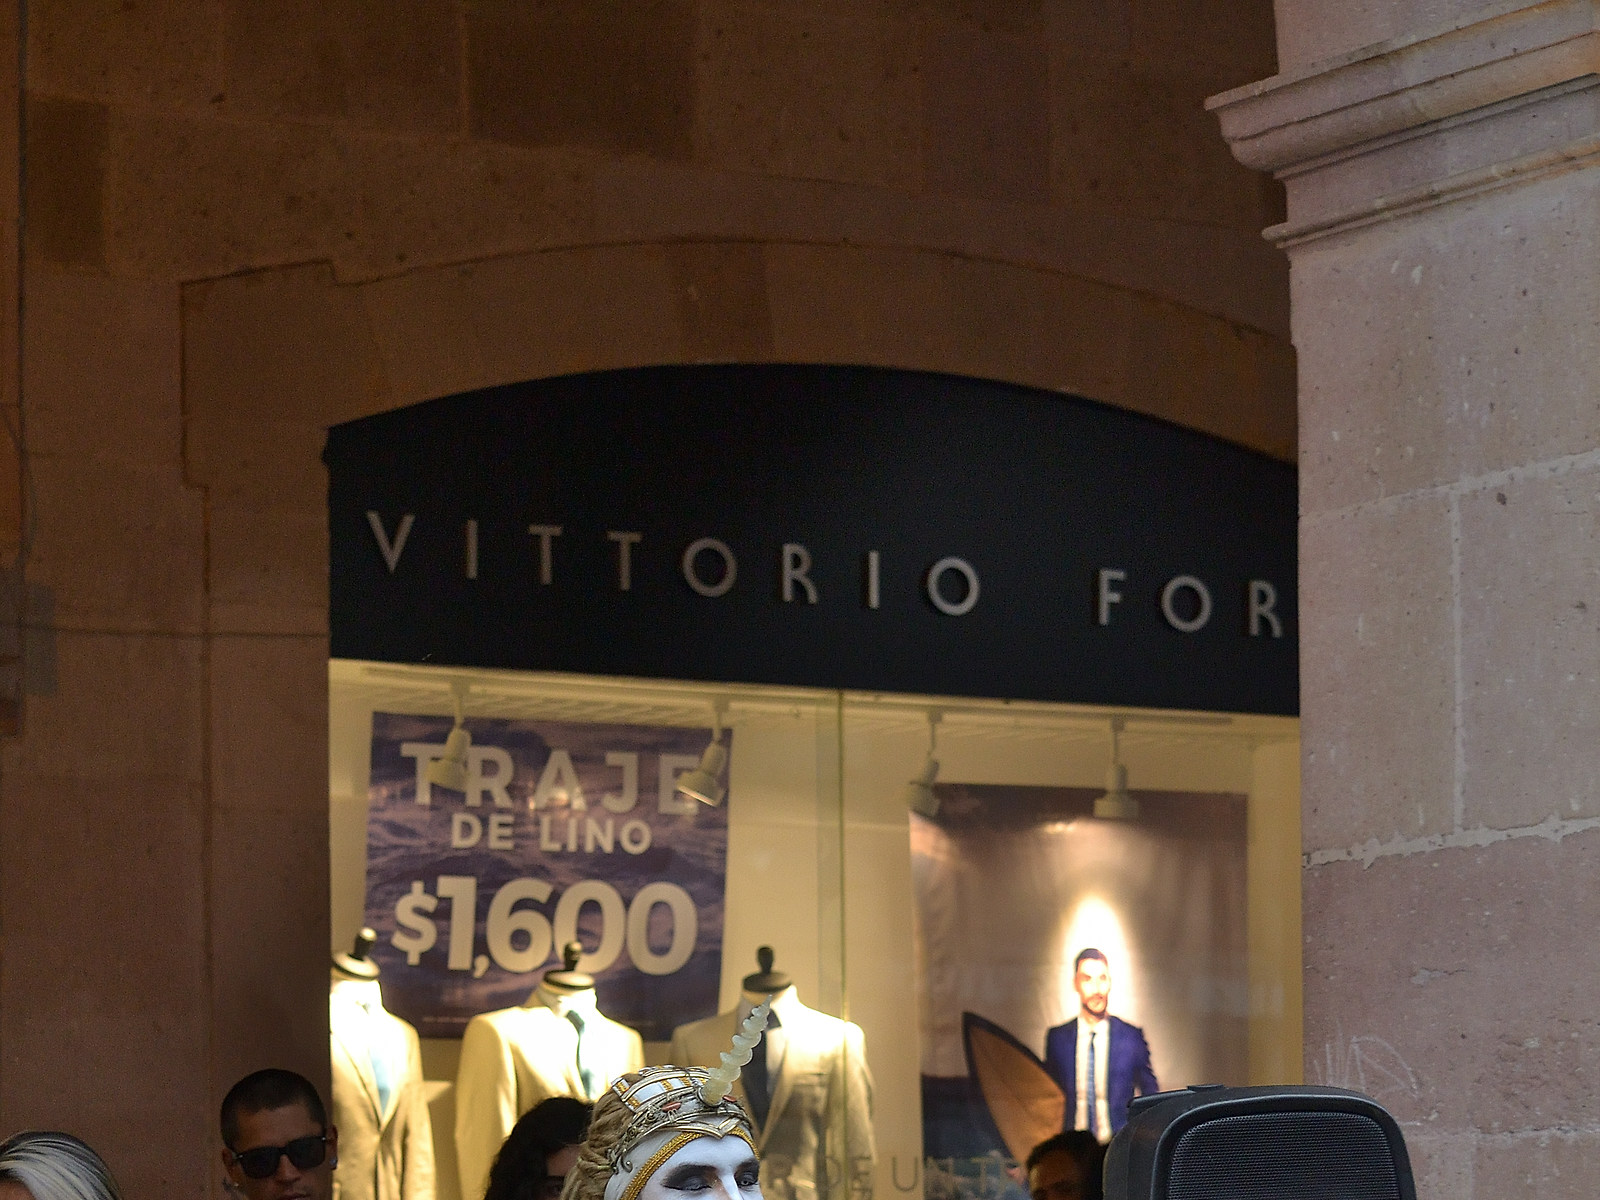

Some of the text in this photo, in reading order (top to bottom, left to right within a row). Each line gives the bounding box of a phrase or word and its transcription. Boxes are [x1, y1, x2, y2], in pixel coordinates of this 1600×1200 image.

[366, 510, 1285, 638] VITTORIO FOR
[401, 742, 697, 816] TRAJE
[451, 812, 653, 856] DE LINO
[391, 875, 697, 978] $1,600
